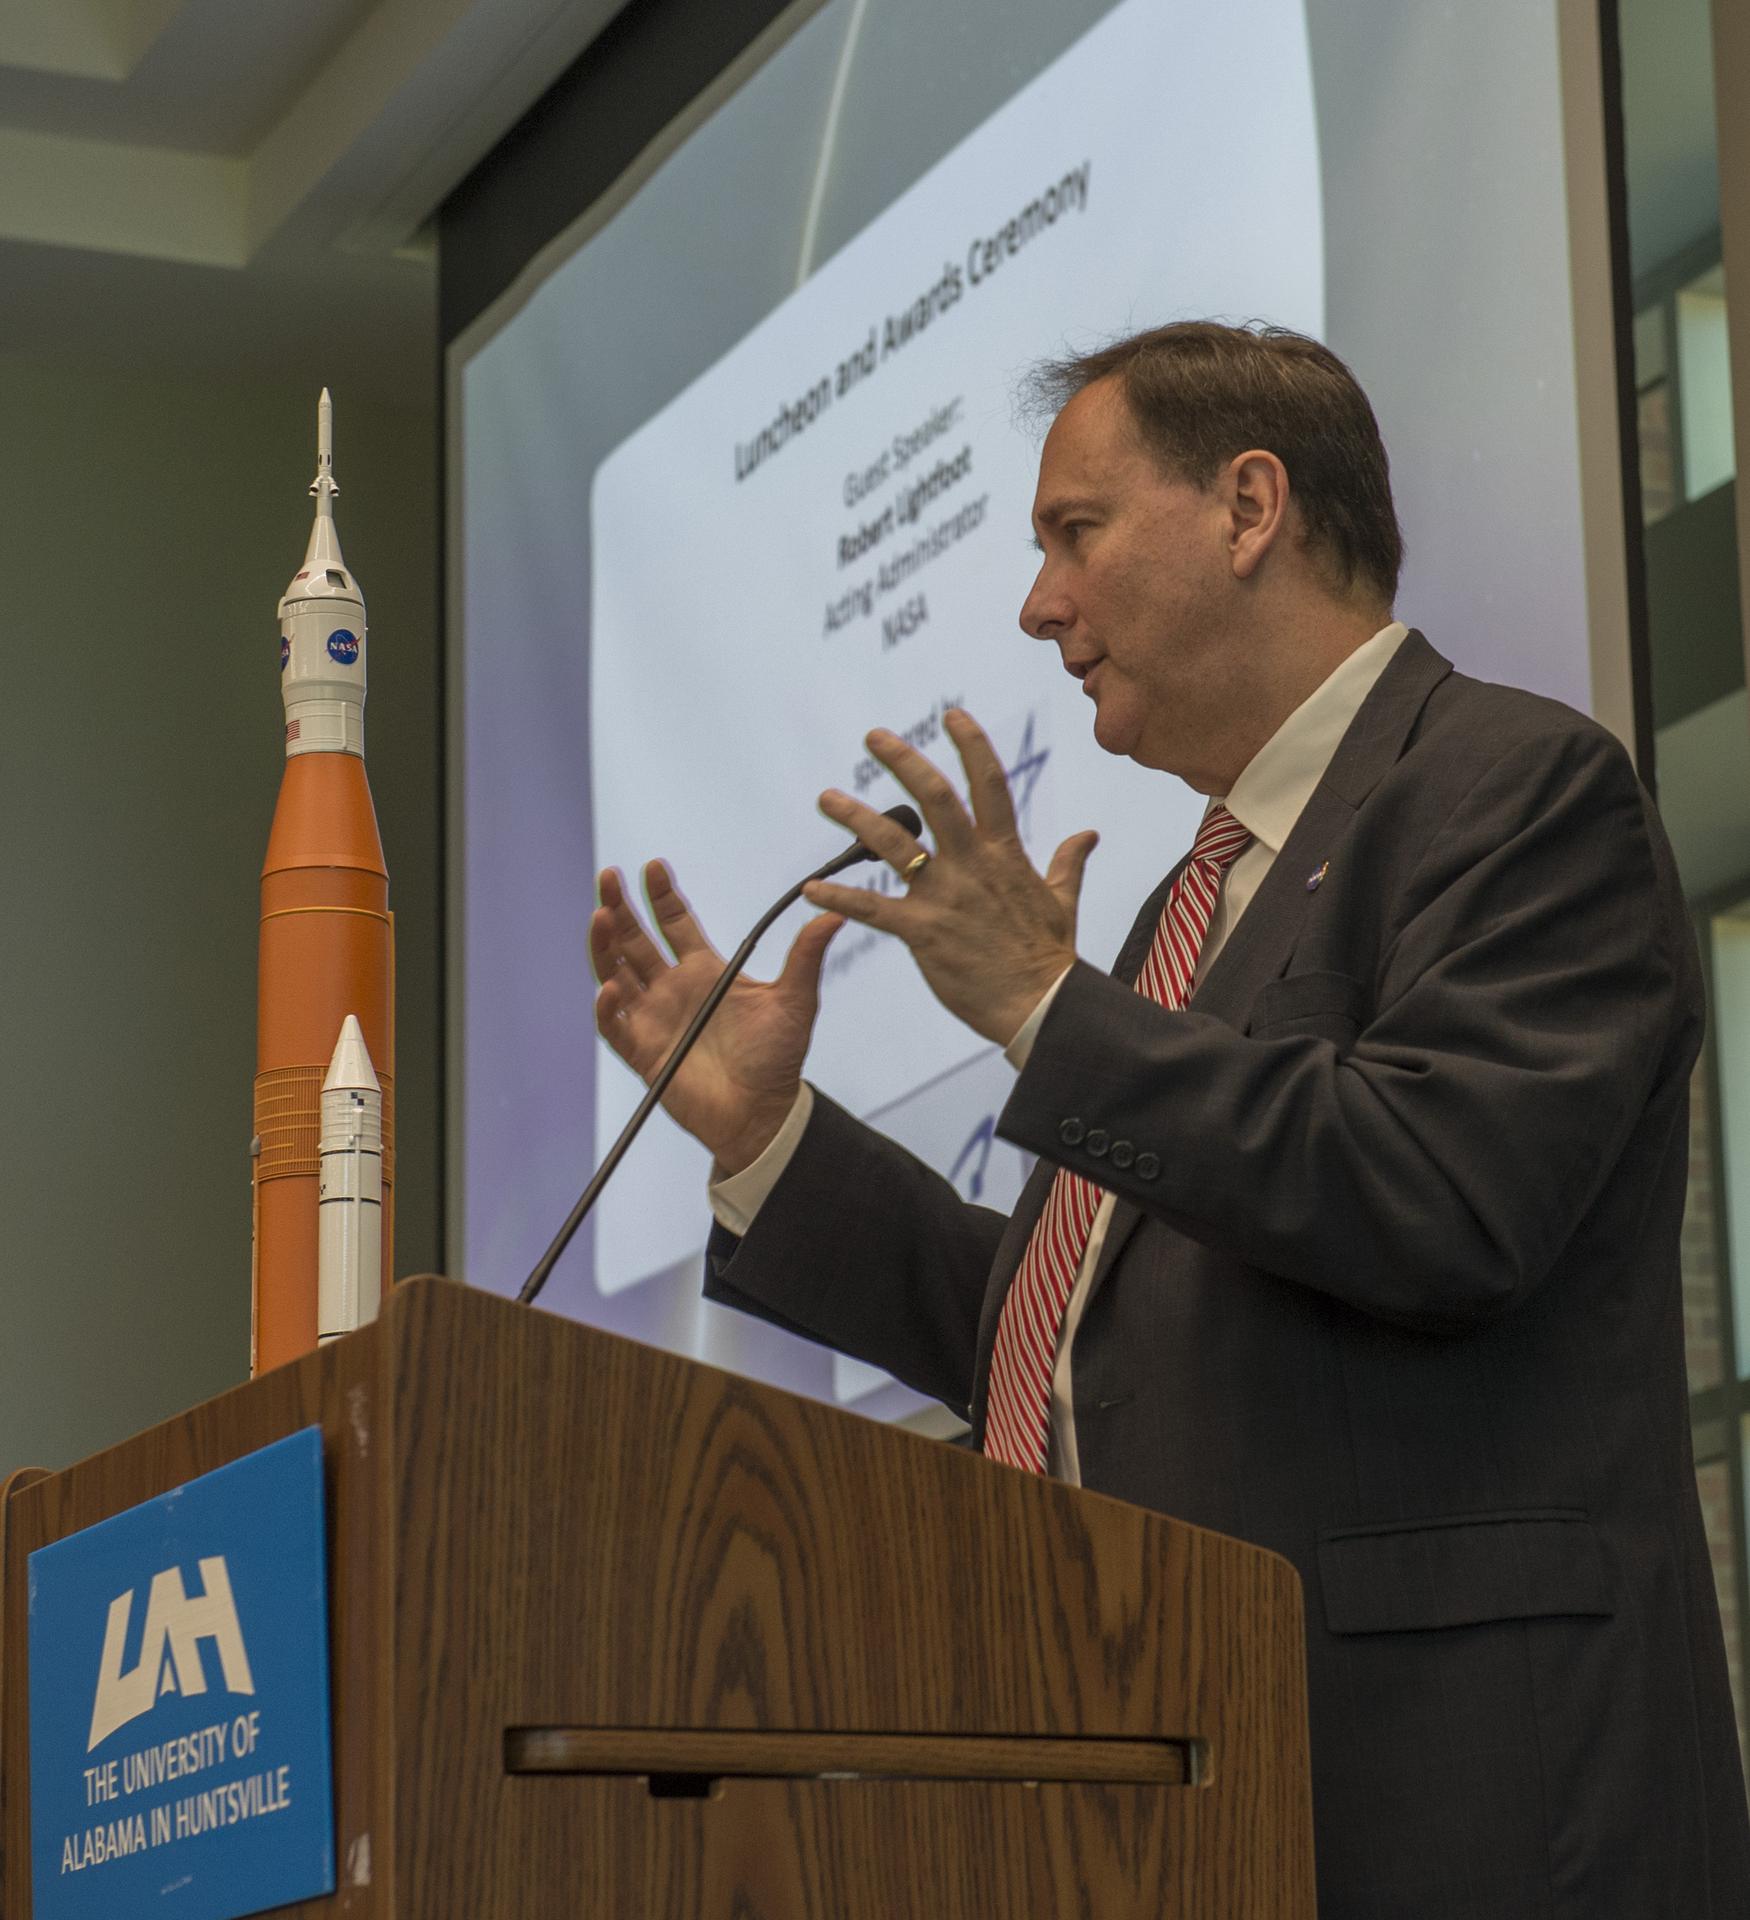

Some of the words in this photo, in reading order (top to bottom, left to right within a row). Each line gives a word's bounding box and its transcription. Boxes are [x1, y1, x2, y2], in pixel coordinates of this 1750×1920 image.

[735, 376, 831, 484] Luncheon
[835, 326, 877, 398] and
[881, 261, 963, 363] Awards
[967, 160, 1090, 288] Ceremony
[838, 505, 894, 567] Robert
[896, 444, 971, 525] Lightfoot
[843, 450, 890, 508] Guest
[825, 580, 873, 636] Acting
[877, 493, 989, 593] Administrator
[330, 641, 358, 653] NASA
[882, 594, 928, 649] NASA
[87, 1555, 255, 1753] UAH
[83, 1760, 119, 1807] THE
[122, 1722, 228, 1795] UNIVERSITY
[232, 1711, 261, 1759] OF
[61, 1813, 147, 1875] ALABAMA
[151, 1804, 171, 1848] IN
[175, 1764, 291, 1840] HUNTSVILLE
